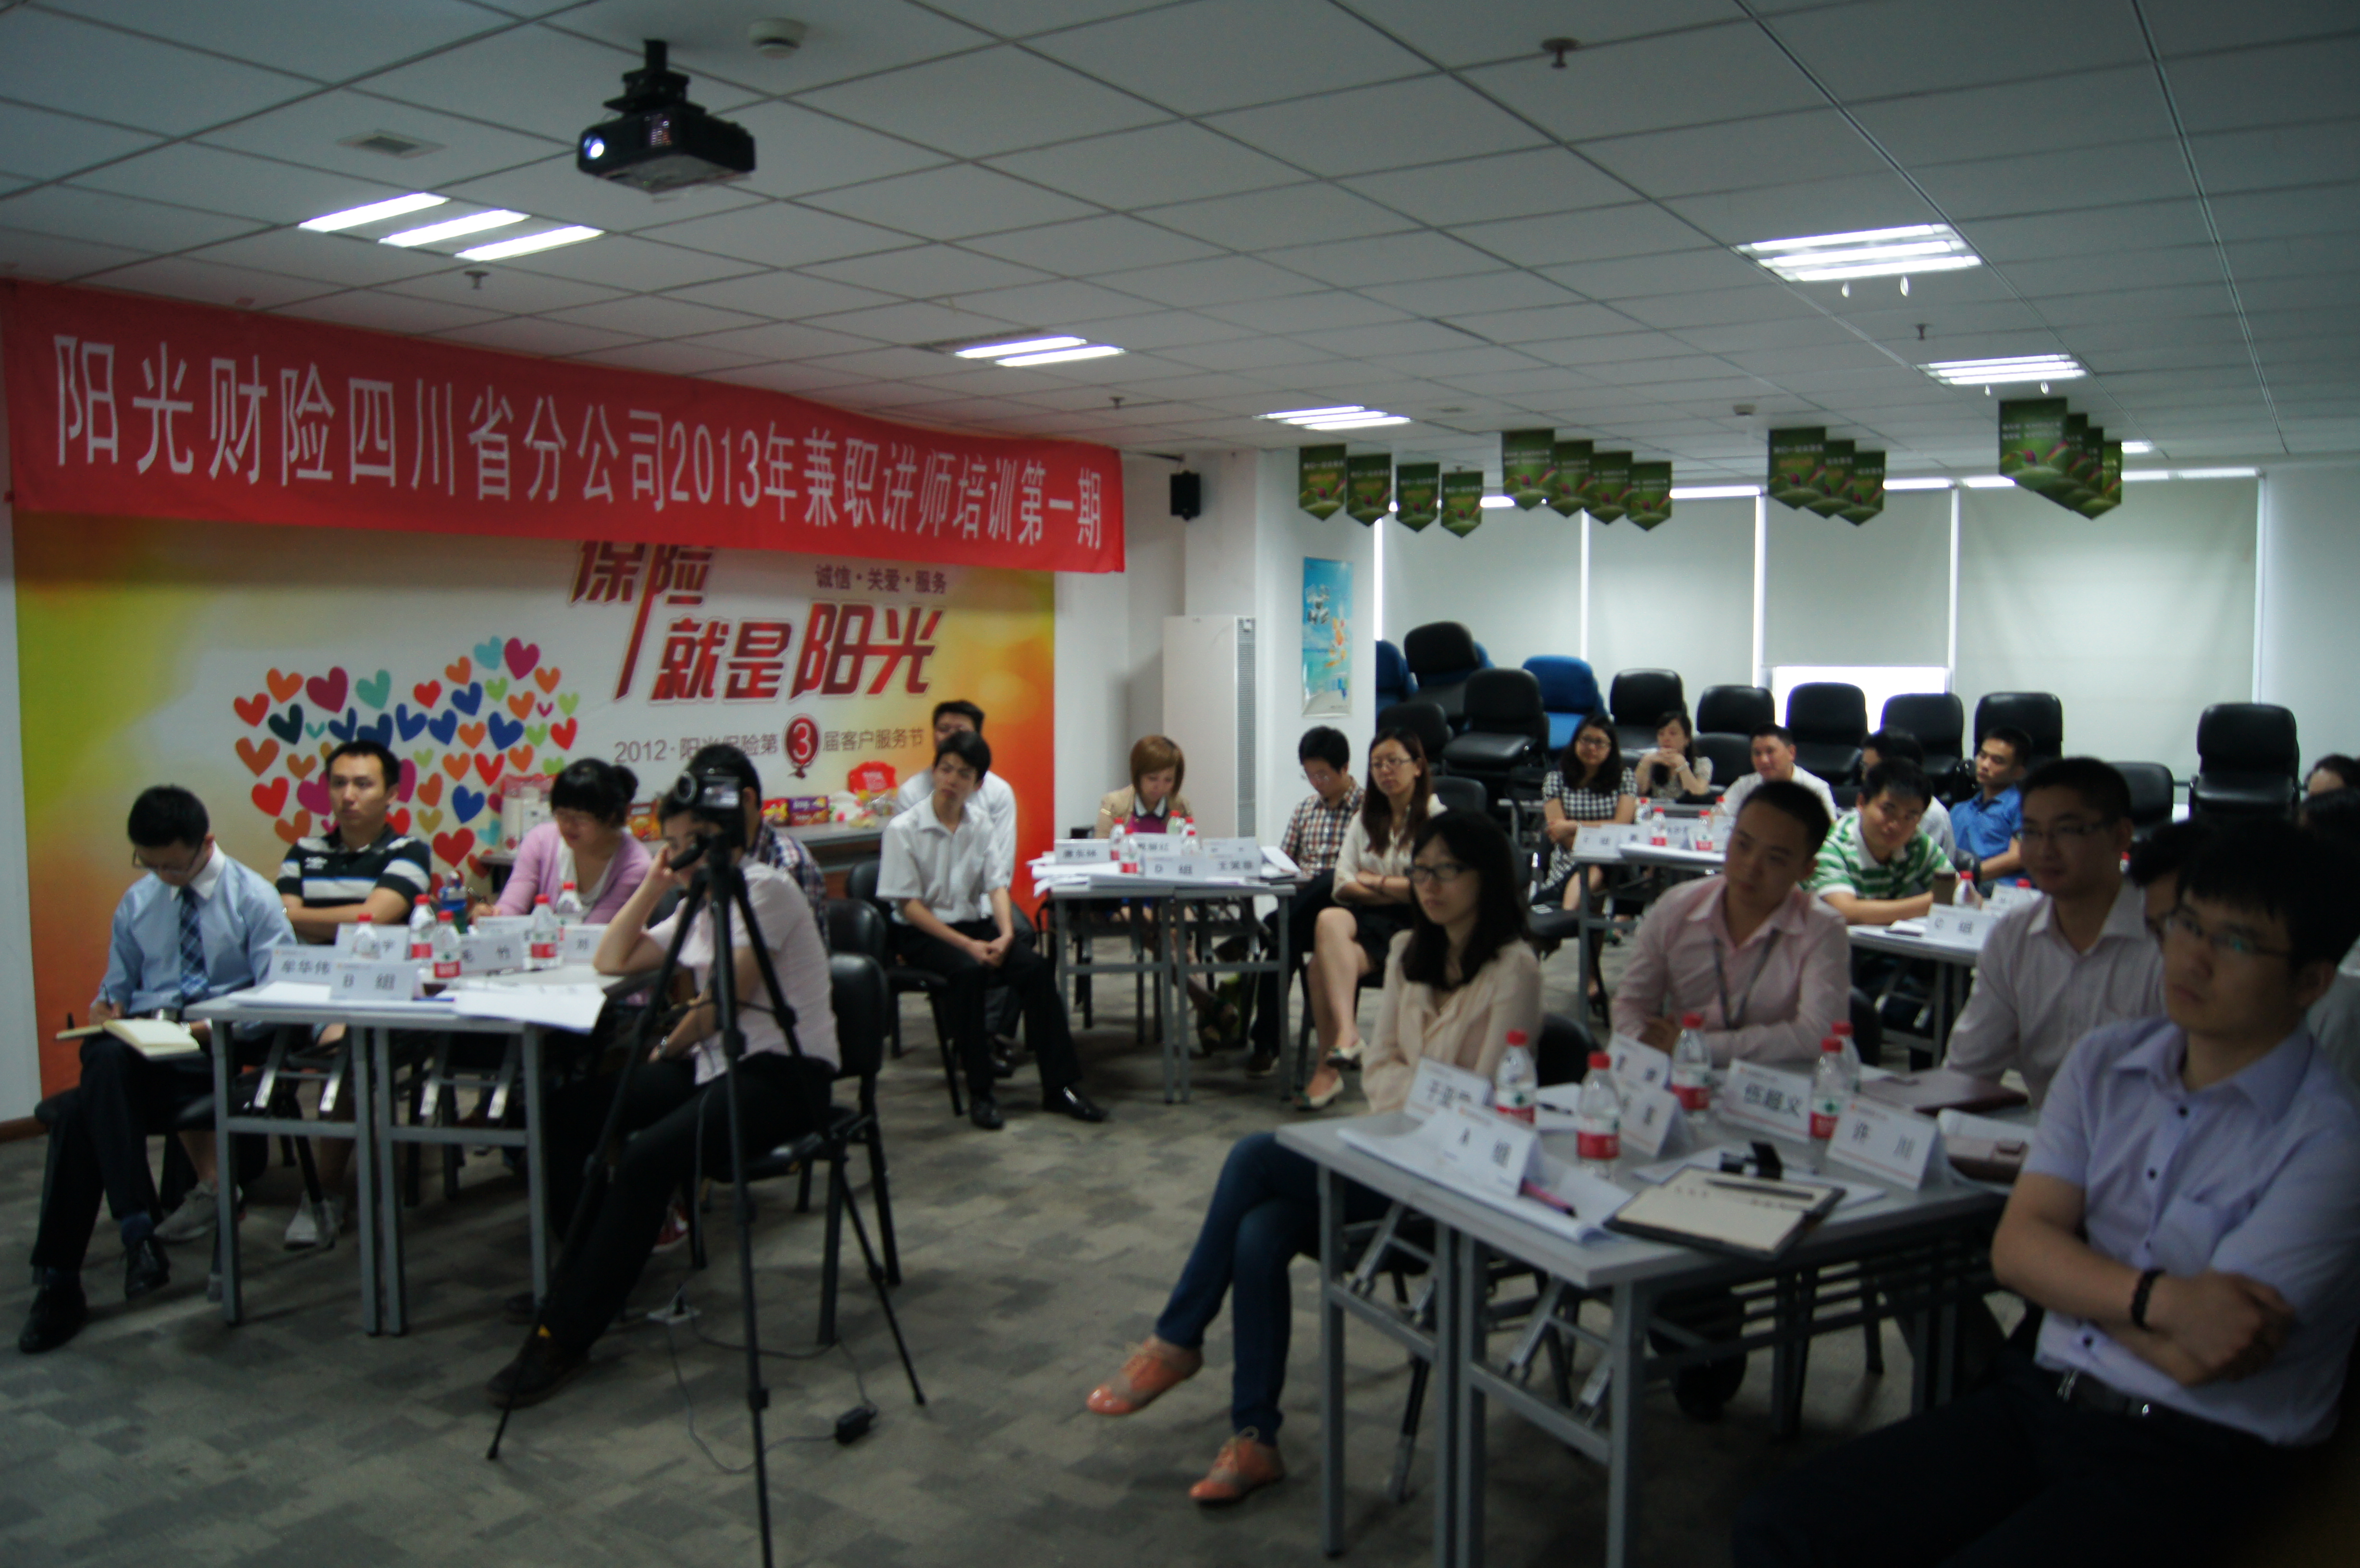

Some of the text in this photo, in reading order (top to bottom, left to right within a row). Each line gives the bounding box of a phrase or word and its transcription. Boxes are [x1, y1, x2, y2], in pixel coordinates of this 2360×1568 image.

[54, 334, 1102, 550] 阳光财险四川省分公司2013年兼职讲师培训第一期
[650, 603, 943, 701] 就是阳光
